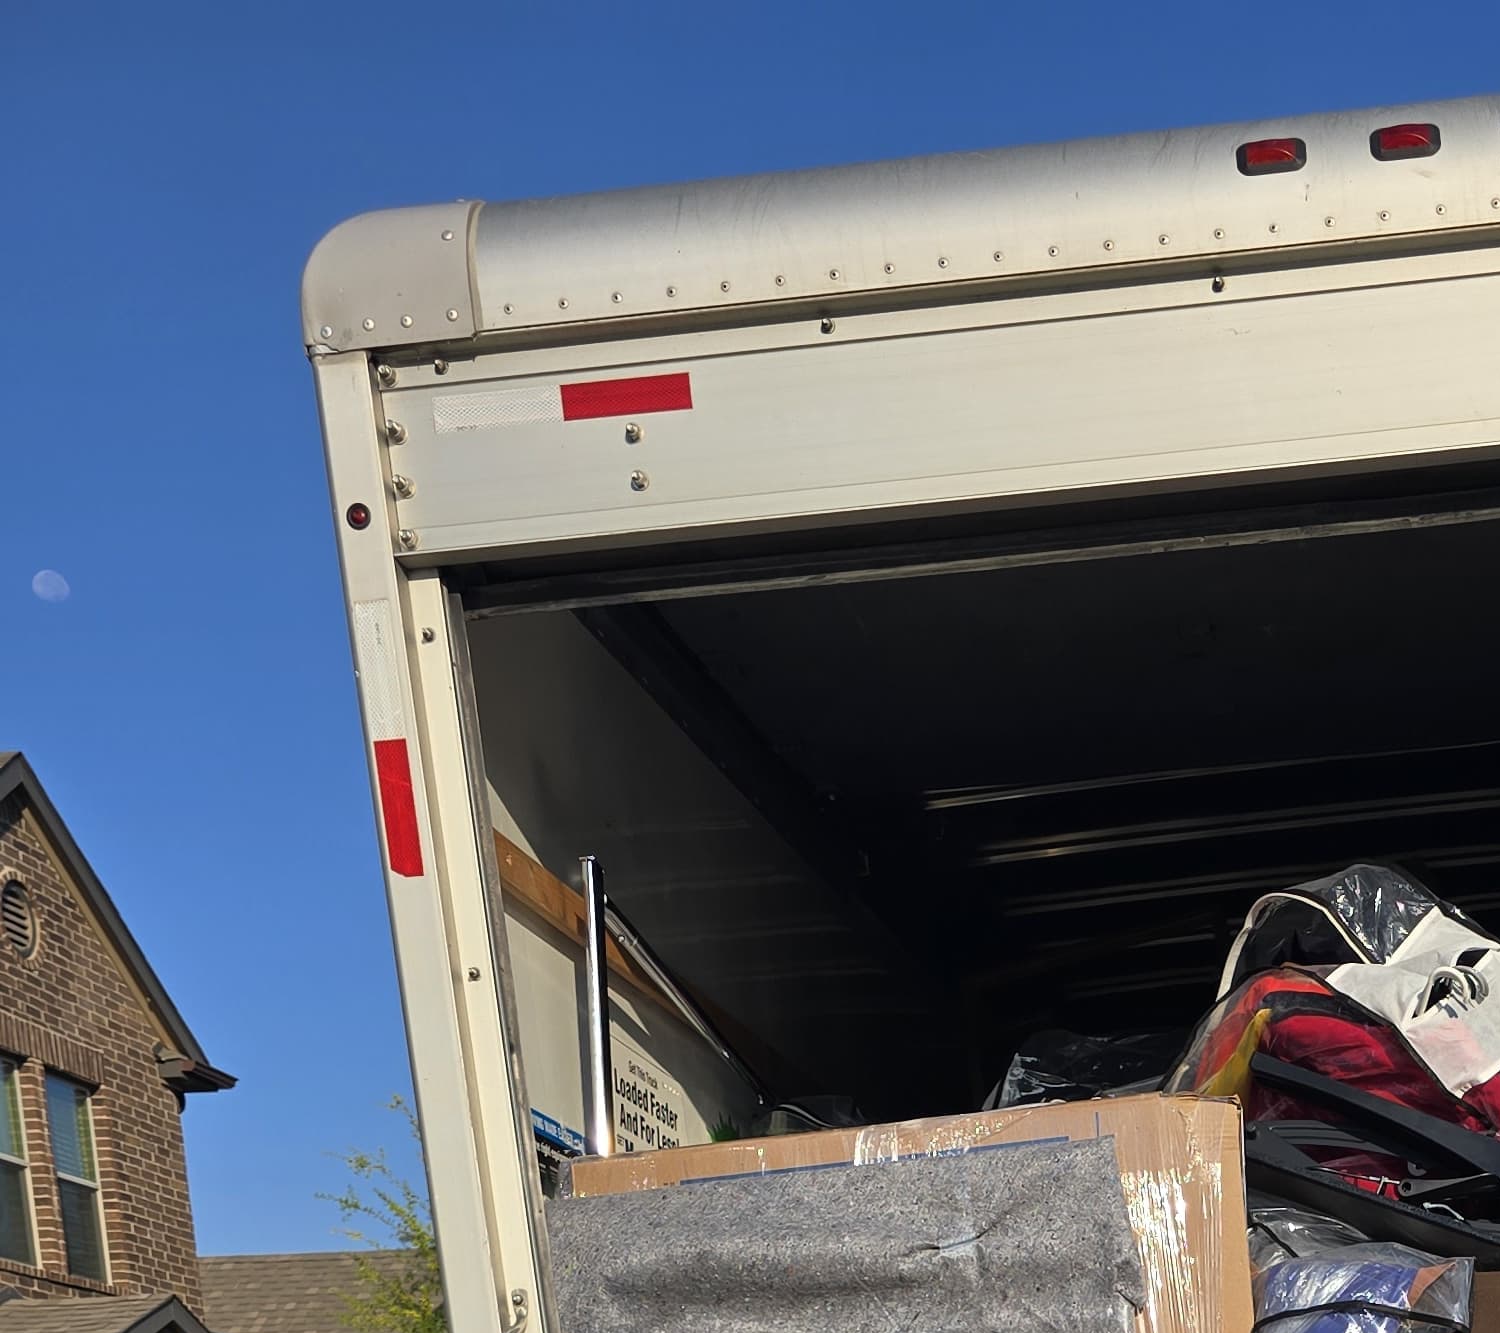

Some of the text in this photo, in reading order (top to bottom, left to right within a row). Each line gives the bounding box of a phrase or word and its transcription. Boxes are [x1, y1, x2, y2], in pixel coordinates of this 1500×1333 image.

[614, 1067, 678, 1131] Loaded Faster
[620, 1103, 638, 1137] And
[640, 1115, 655, 1146] For
